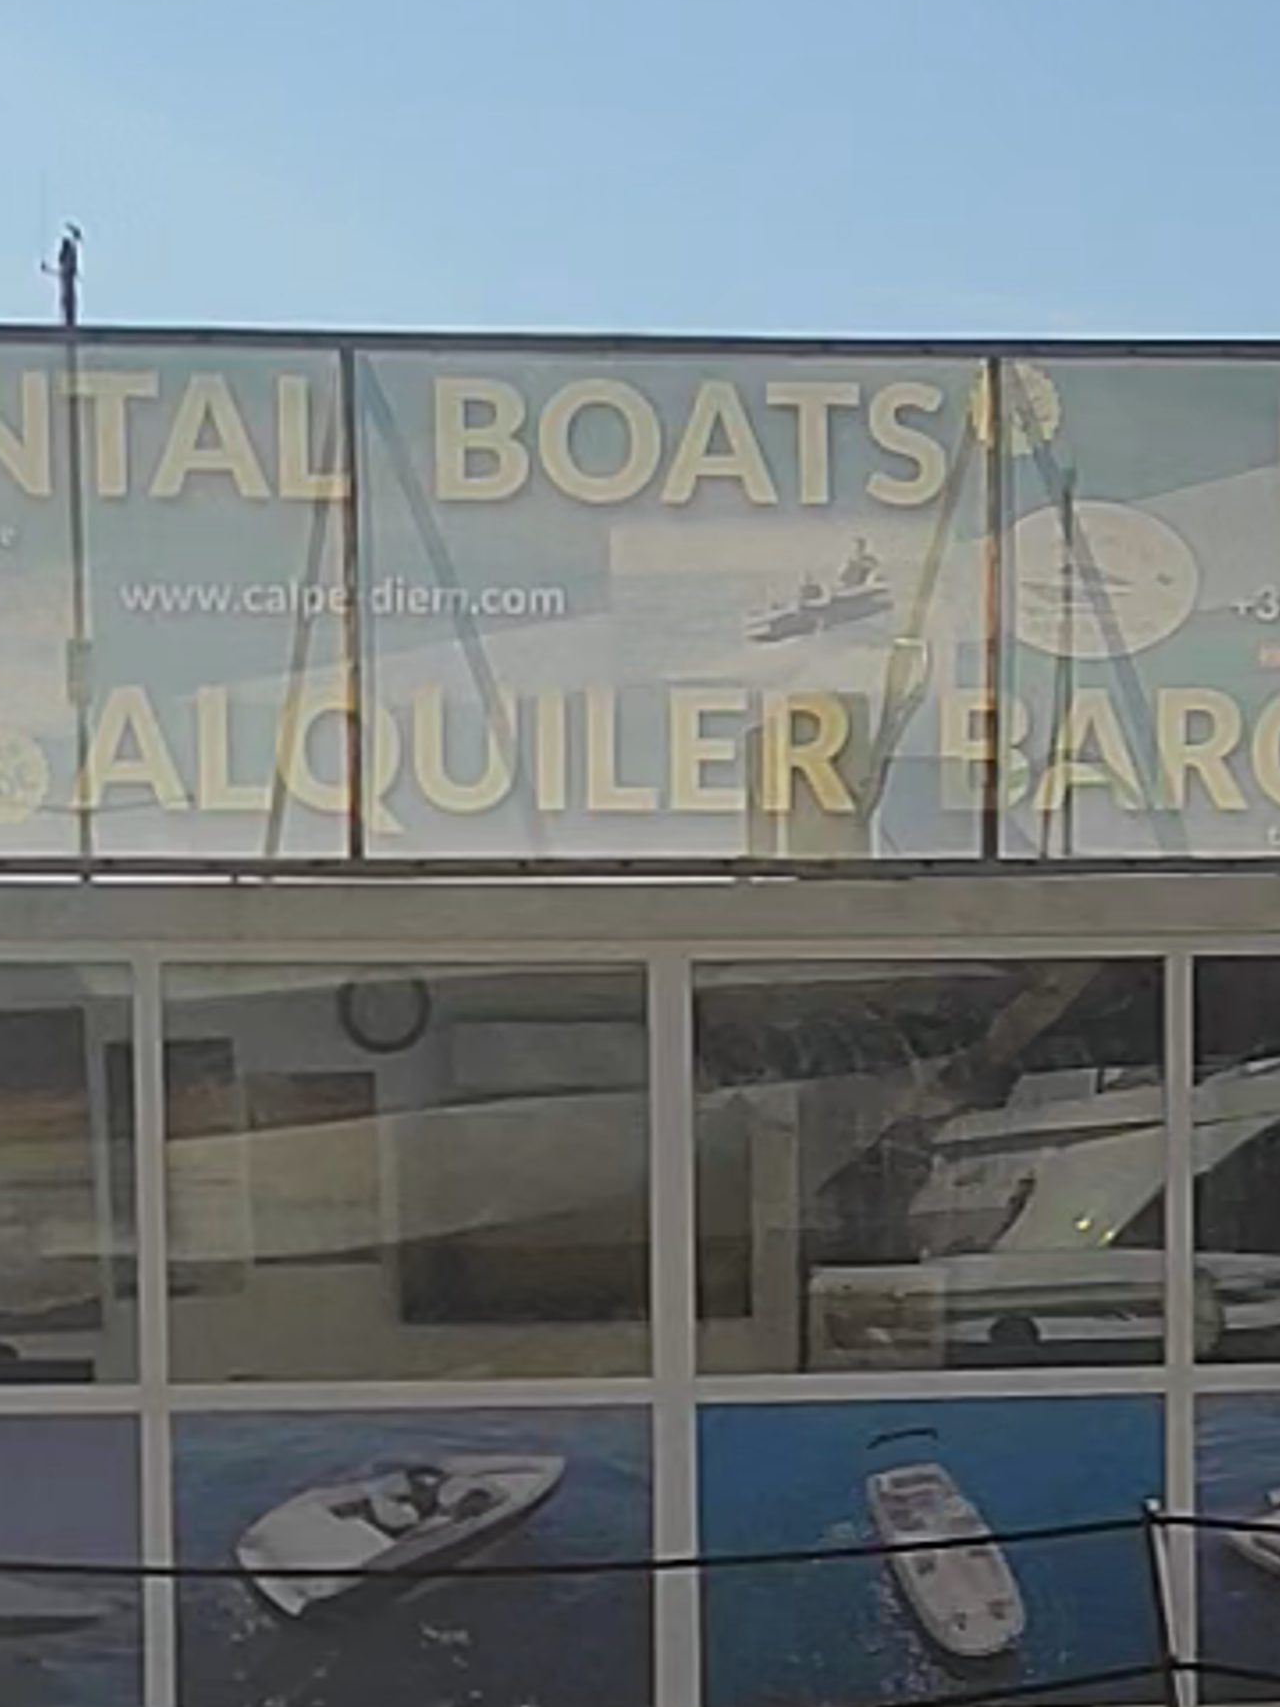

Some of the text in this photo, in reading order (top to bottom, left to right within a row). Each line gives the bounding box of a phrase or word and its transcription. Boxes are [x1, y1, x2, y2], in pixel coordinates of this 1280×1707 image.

[434, 375, 948, 507] BOATS
[121, 576, 565, 621] www.calpediem.com
[72, 685, 856, 836] ALQUILER
